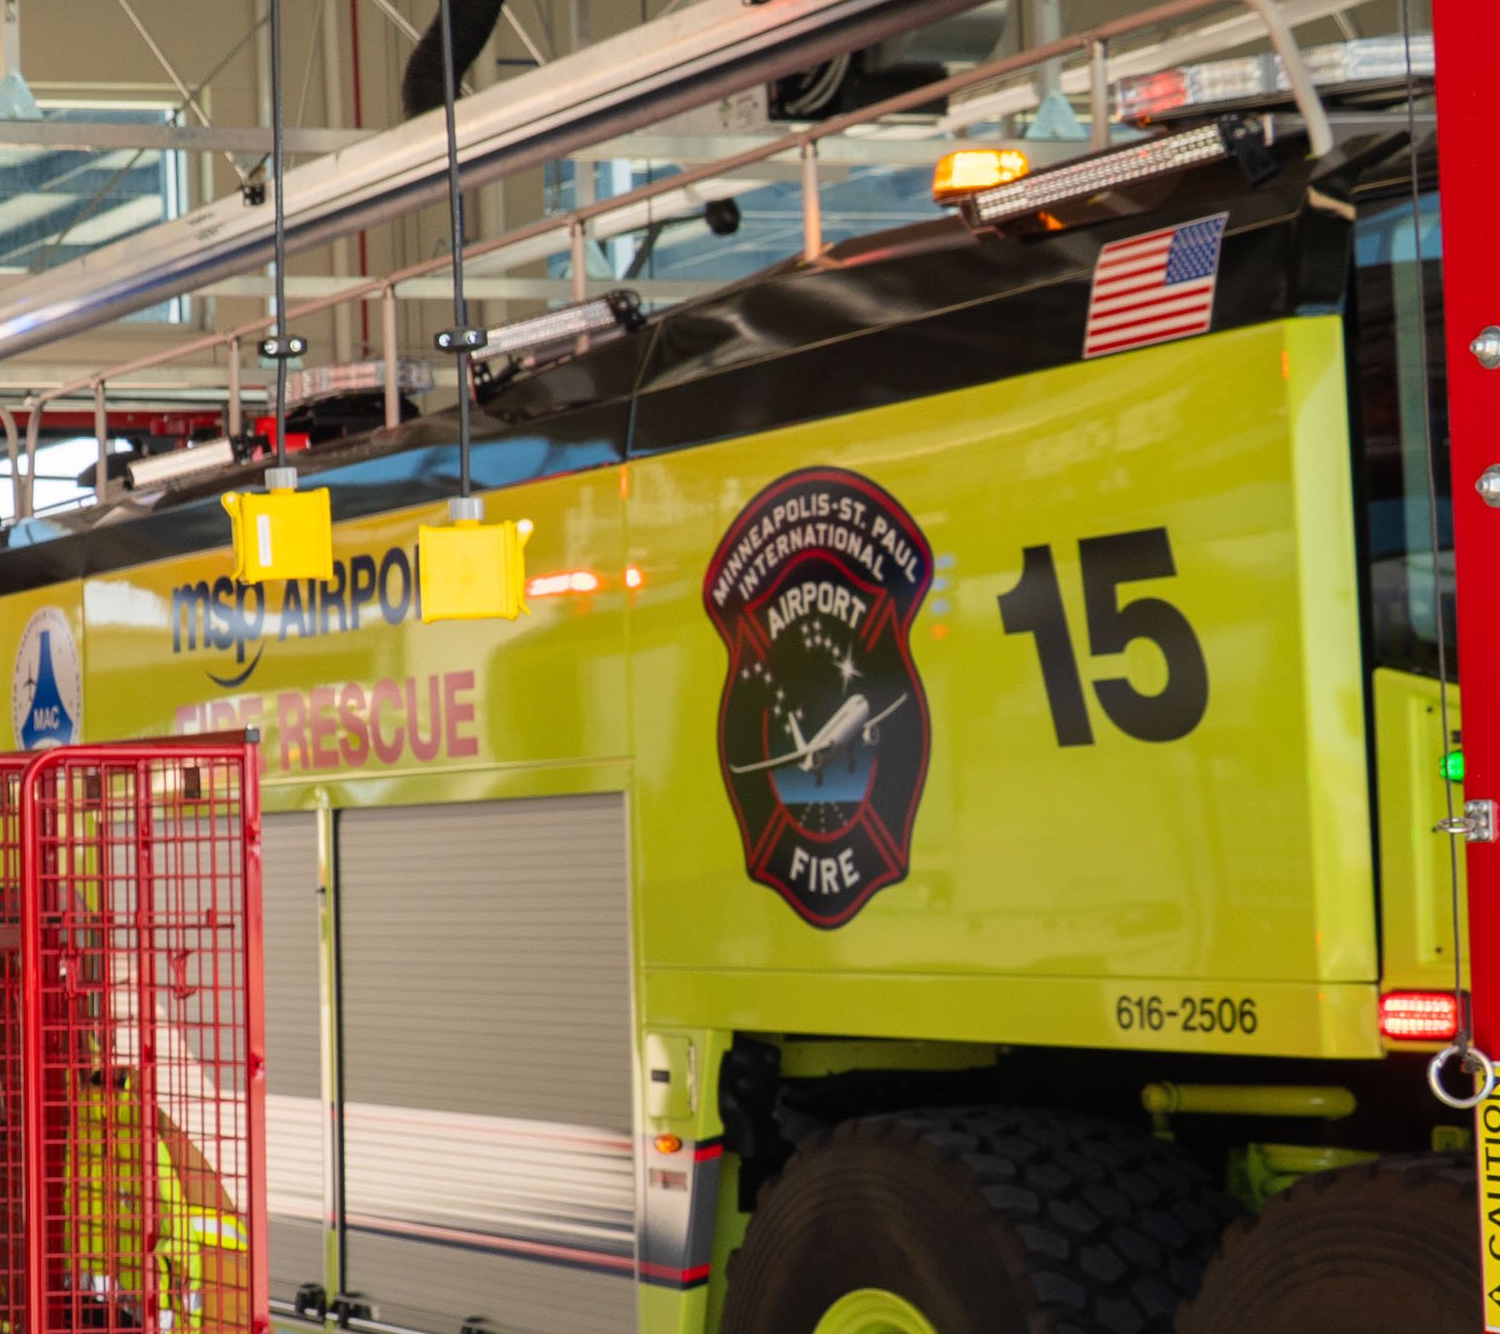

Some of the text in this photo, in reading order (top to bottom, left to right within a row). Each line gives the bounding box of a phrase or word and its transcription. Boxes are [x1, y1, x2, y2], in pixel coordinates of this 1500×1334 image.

[738, 522, 886, 601] INTERNATIONAL
[872, 516, 919, 584] PAUL
[172, 575, 265, 664] msp
[767, 581, 867, 640] AIRPORT
[996, 526, 1210, 748] 15
[33, 705, 61, 732] MAC
[278, 670, 479, 773] RESCUE
[789, 845, 861, 895] FIRE
[1116, 995, 1259, 1034] 616-2506
